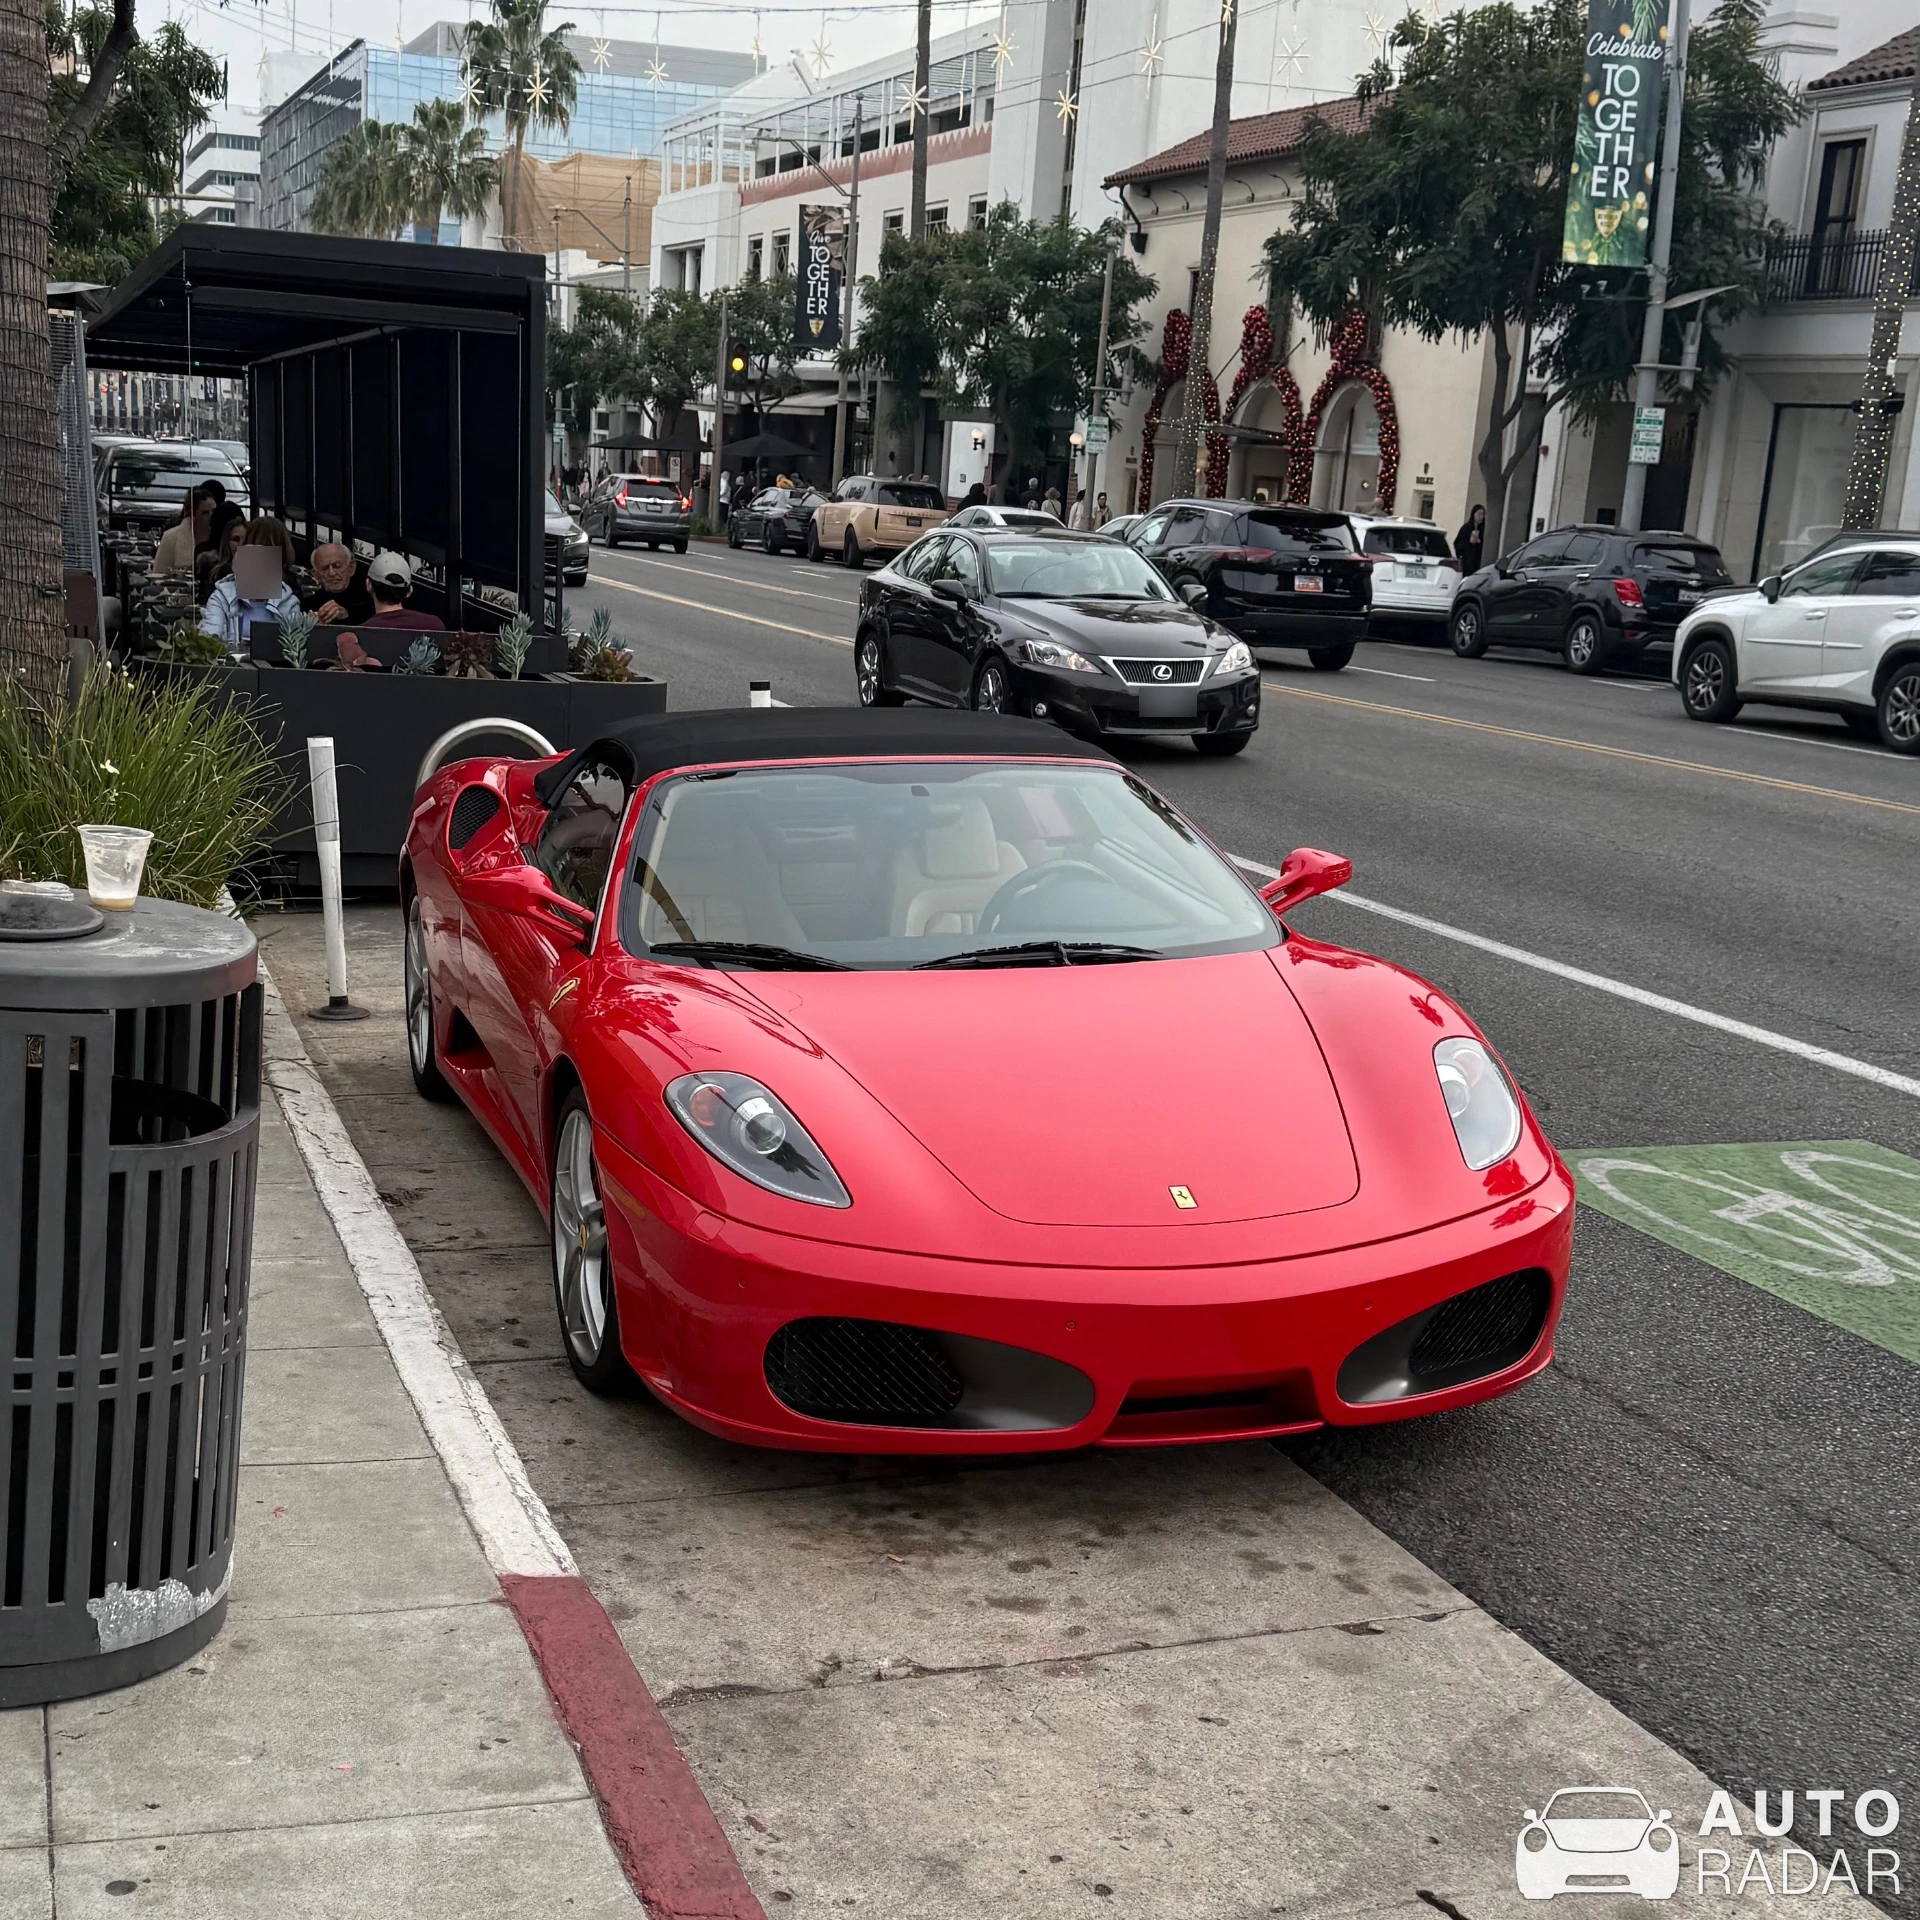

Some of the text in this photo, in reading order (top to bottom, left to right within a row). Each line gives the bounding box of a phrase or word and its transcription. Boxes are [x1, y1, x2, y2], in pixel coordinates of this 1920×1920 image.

[1586, 32, 1664, 60] Celebrate
[1602, 63, 1640, 97] TO
[1594, 98, 1638, 132] GE
[1594, 132, 1634, 166] TH
[1590, 165, 1630, 199] ER
[809, 229, 831, 246] Give
[809, 245, 830, 263] TO
[807, 263, 830, 281] GE
[807, 280, 829, 298] TH
[806, 297, 828, 315] ER
